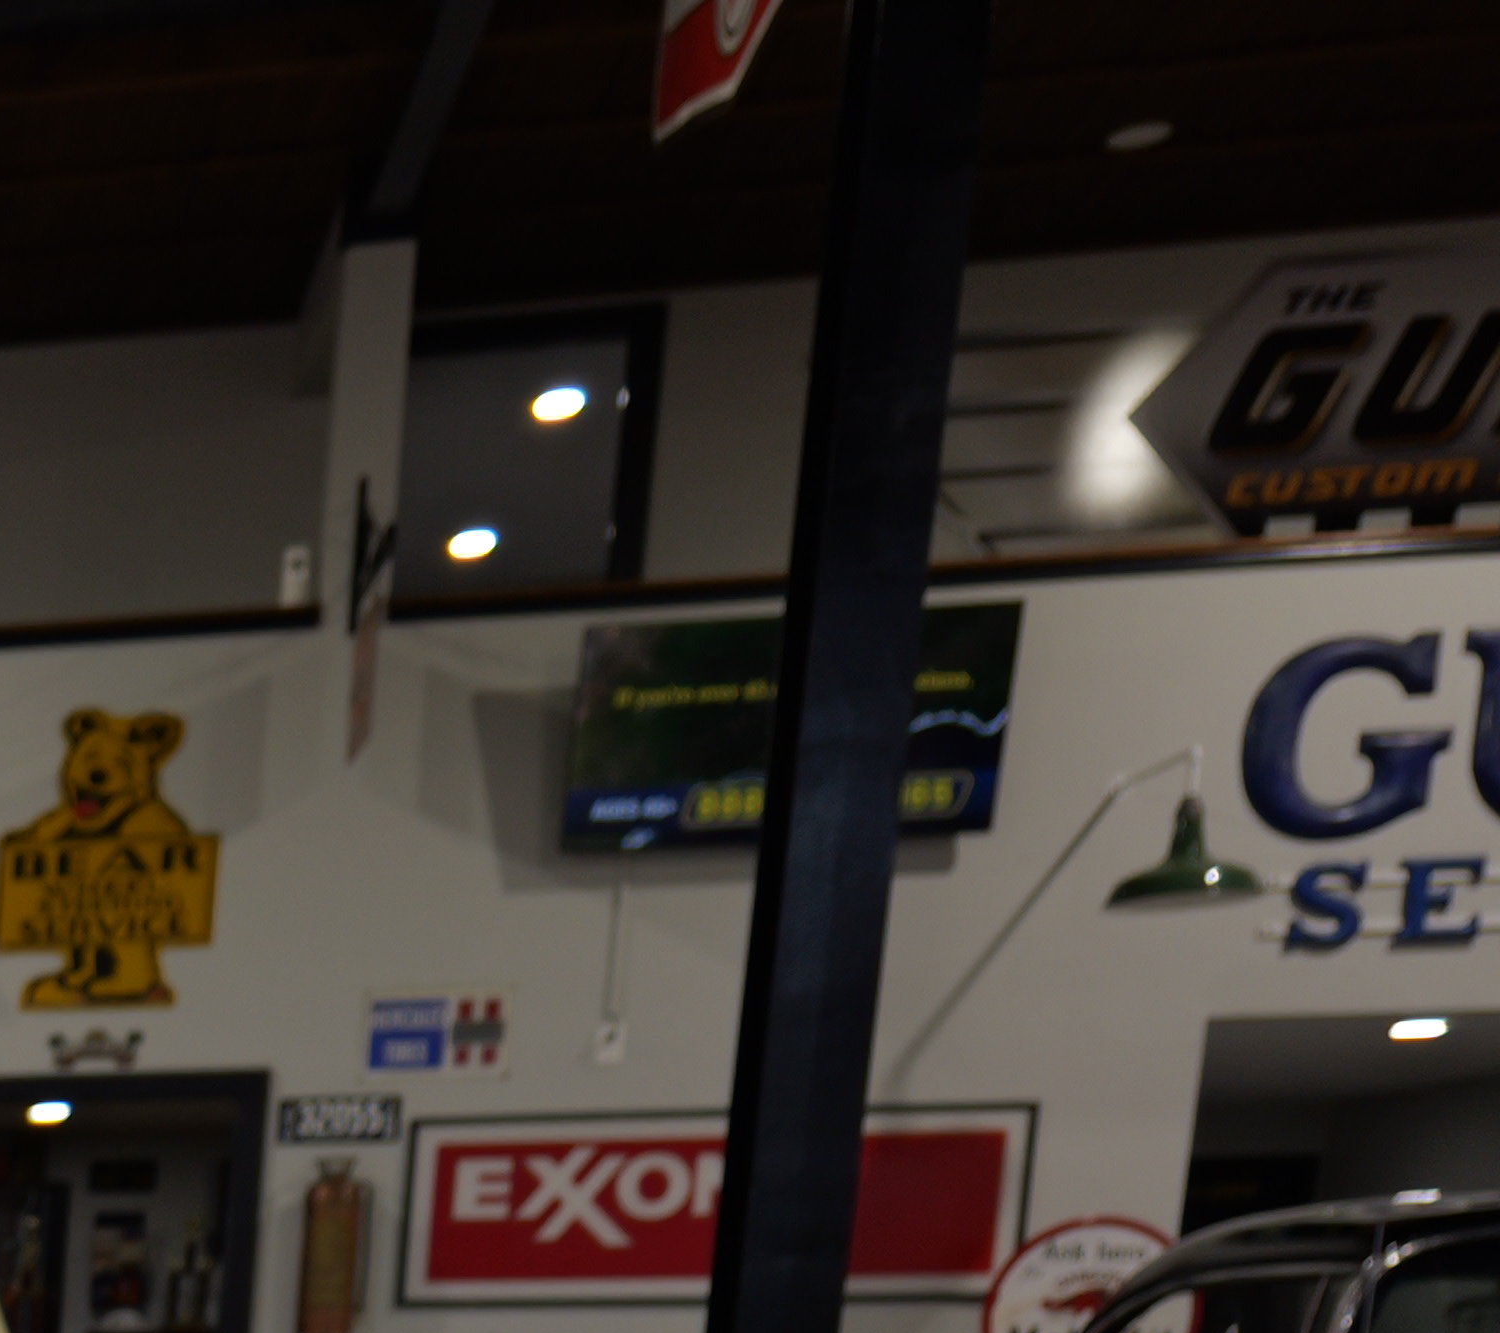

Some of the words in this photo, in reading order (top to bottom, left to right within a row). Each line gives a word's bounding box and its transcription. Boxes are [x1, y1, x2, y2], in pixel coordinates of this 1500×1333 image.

[1284, 280, 1388, 316] THE
[1209, 311, 1500, 453] GU
[1226, 457, 1480, 506] CUSTOM
[13, 845, 199, 879] BEAR
